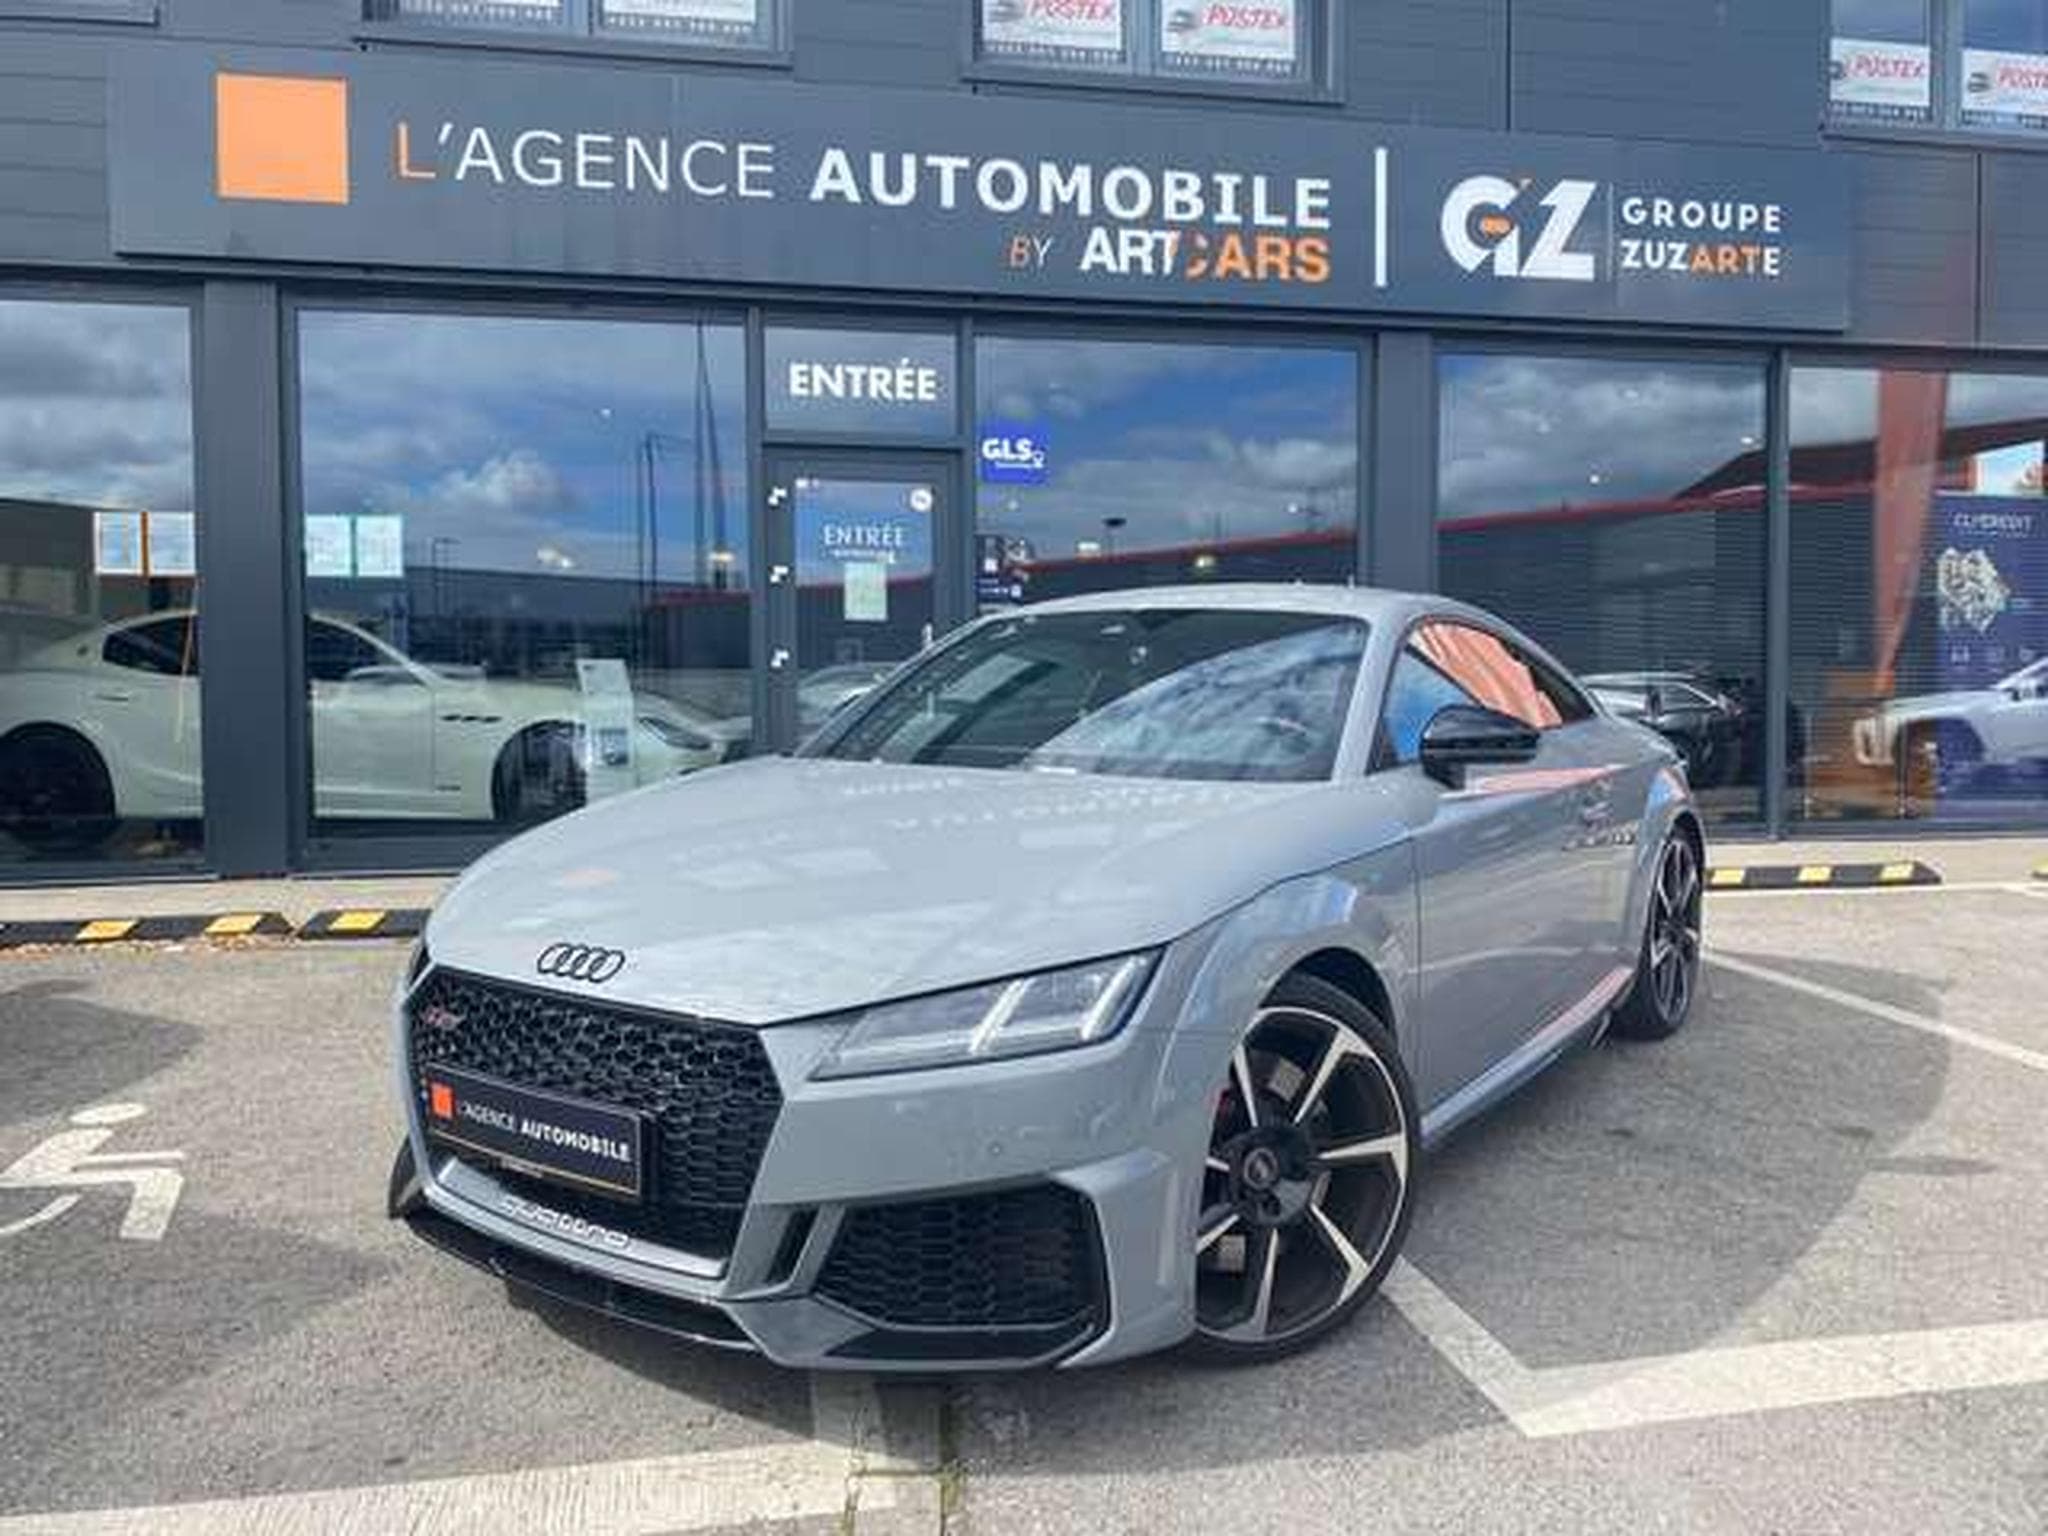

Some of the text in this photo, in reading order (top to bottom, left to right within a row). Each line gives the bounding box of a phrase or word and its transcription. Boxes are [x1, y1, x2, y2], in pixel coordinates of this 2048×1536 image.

[395, 122, 1333, 229] L'AGENCE AUTOMOBILE
[1620, 196, 1782, 234] GROUPE
[1008, 235, 1053, 270] BY
[1620, 239, 1782, 277] ZUZARTE
[789, 357, 937, 401] ENTRÉE
[982, 437, 1032, 460] GLS
[823, 523, 904, 547] ENTRÉE
[521, 1119, 630, 1162] AUTOMOBILE
